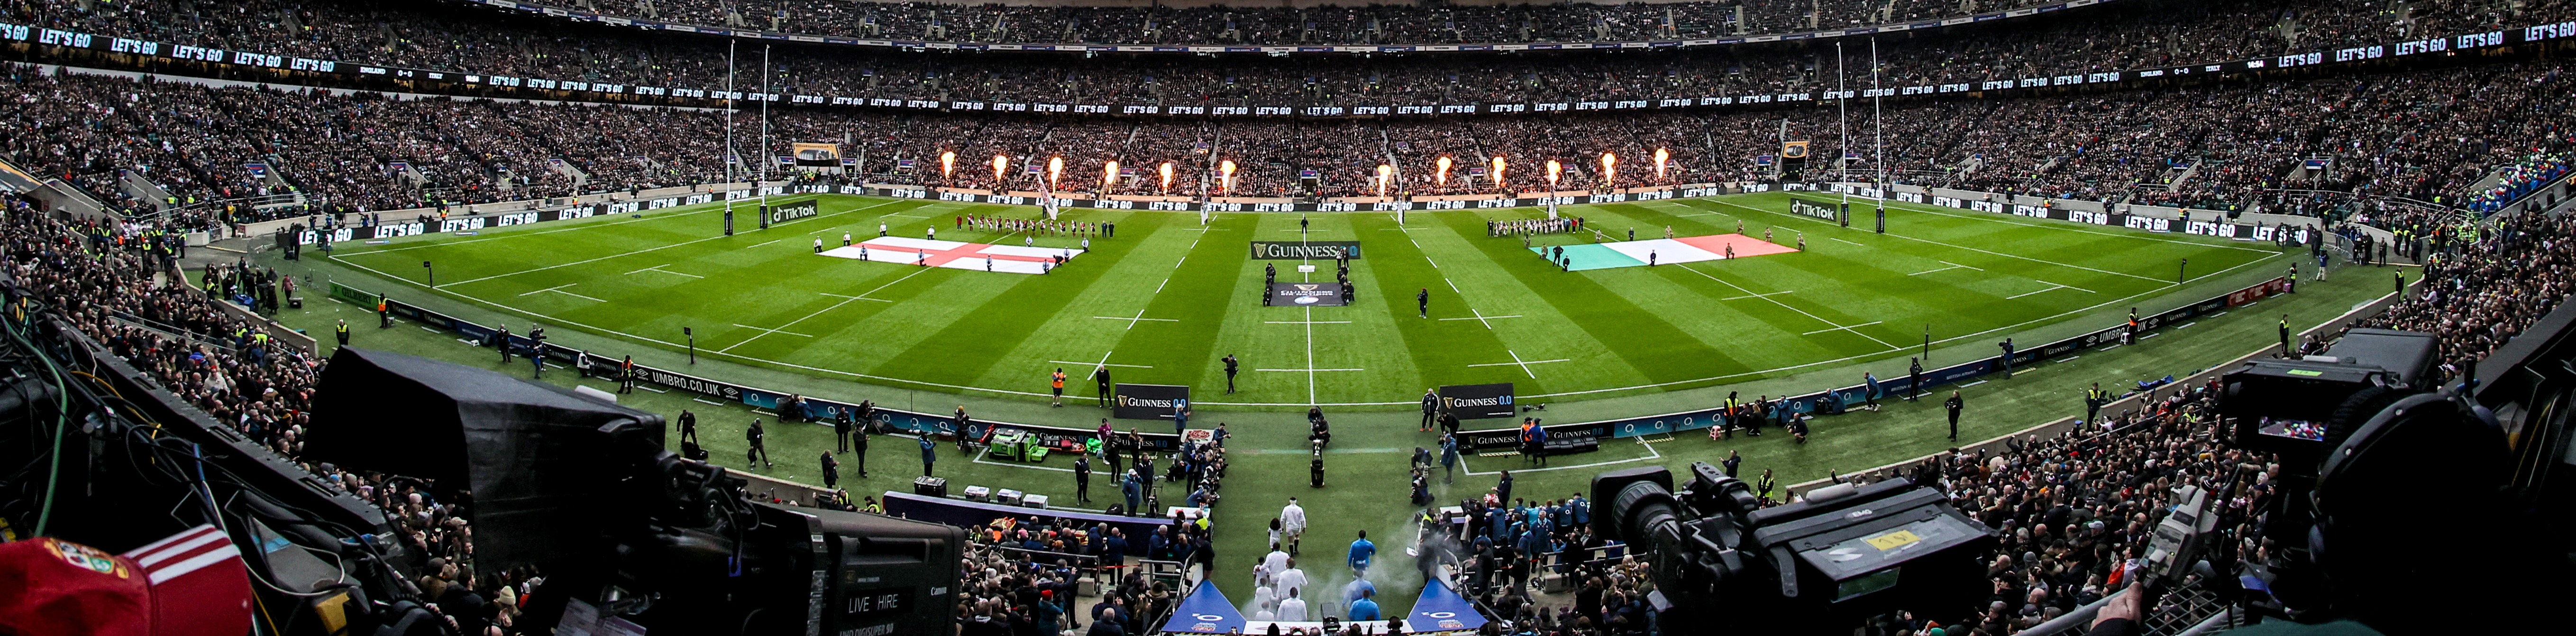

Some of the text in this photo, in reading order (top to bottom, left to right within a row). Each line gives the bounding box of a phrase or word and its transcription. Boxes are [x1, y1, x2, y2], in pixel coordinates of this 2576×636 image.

[13, 25, 28, 41] GO
[2526, 22, 2575, 41] LET'S GO
[39, 29, 90, 47] LET'S GO
[2458, 31, 2502, 48] LET'S GO
[111, 38, 156, 55] LET'S GO
[2396, 38, 2446, 55] LET'S GO
[173, 45, 222, 61] LET'S GO
[2337, 46, 2382, 61] LET'S GO
[235, 52, 281, 67] LET'S GO
[291, 58, 334, 72] LET'S GO
[2279, 53, 2321, 67] LET'S GO
[360, 66, 386, 74] ENGLAND
[490, 76, 519, 86] LET'S GO
[528, 79, 555, 88] LET'S GO
[2021, 78, 2047, 87] LET'S GO
[2055, 75, 2082, 85] LET'S GO
[2089, 72, 2119, 83] LET'S GO
[561, 81, 578, 90] LET'S
[593, 83, 623, 92] LET'S GO
[636, 86, 654, 94] LET'S
[1903, 86, 1922, 94] LET'S
[1982, 80, 2013, 90] LET'S GO
[833, 96, 852, 104] LET'S
[686, 194, 712, 205] LET'S GO
[940, 193, 974, 202] LET'S GO
[1638, 192, 1660, 200] LET'S
[1897, 192, 1922, 203] LET'S GO
[1934, 196, 1960, 208] LET'S GO
[607, 202, 638, 215] LET'S GO
[649, 198, 677, 210] LET'S GO
[1149, 202, 1188, 211] LET'S GO
[1317, 203, 1356, 211] LET'S GO
[1478, 199, 1516, 208] LET'S GO
[1971, 201, 2002, 213] LET'S GO
[559, 207, 593, 220] LET'S GO
[783, 204, 816, 220] TikTok
[1801, 203, 1835, 220] TikTok
[2013, 205, 2047, 218] LET'S GO
[498, 212, 537, 227] LET'S GO
[2069, 211, 2107, 225] LET'S GO
[2125, 216, 2168, 230] LET'S GO
[375, 223, 423, 239] LET'S GO
[440, 218, 484, 232] LET'S GO
[2186, 221, 2235, 237] LET'S GO
[335, 229, 352, 242] GO
[342, 287, 372, 305] GILBERT
[652, 371, 720, 396] UMBRO.CO.UK
[1127, 397, 1171, 408] GUINNESS
[1453, 395, 1512, 407] GUINNESS 0.0
[1592, 427, 1603, 436] 0.0
[1478, 436, 1516, 445] GUINNESS
[849, 594, 898, 614] LIVE HIRE
